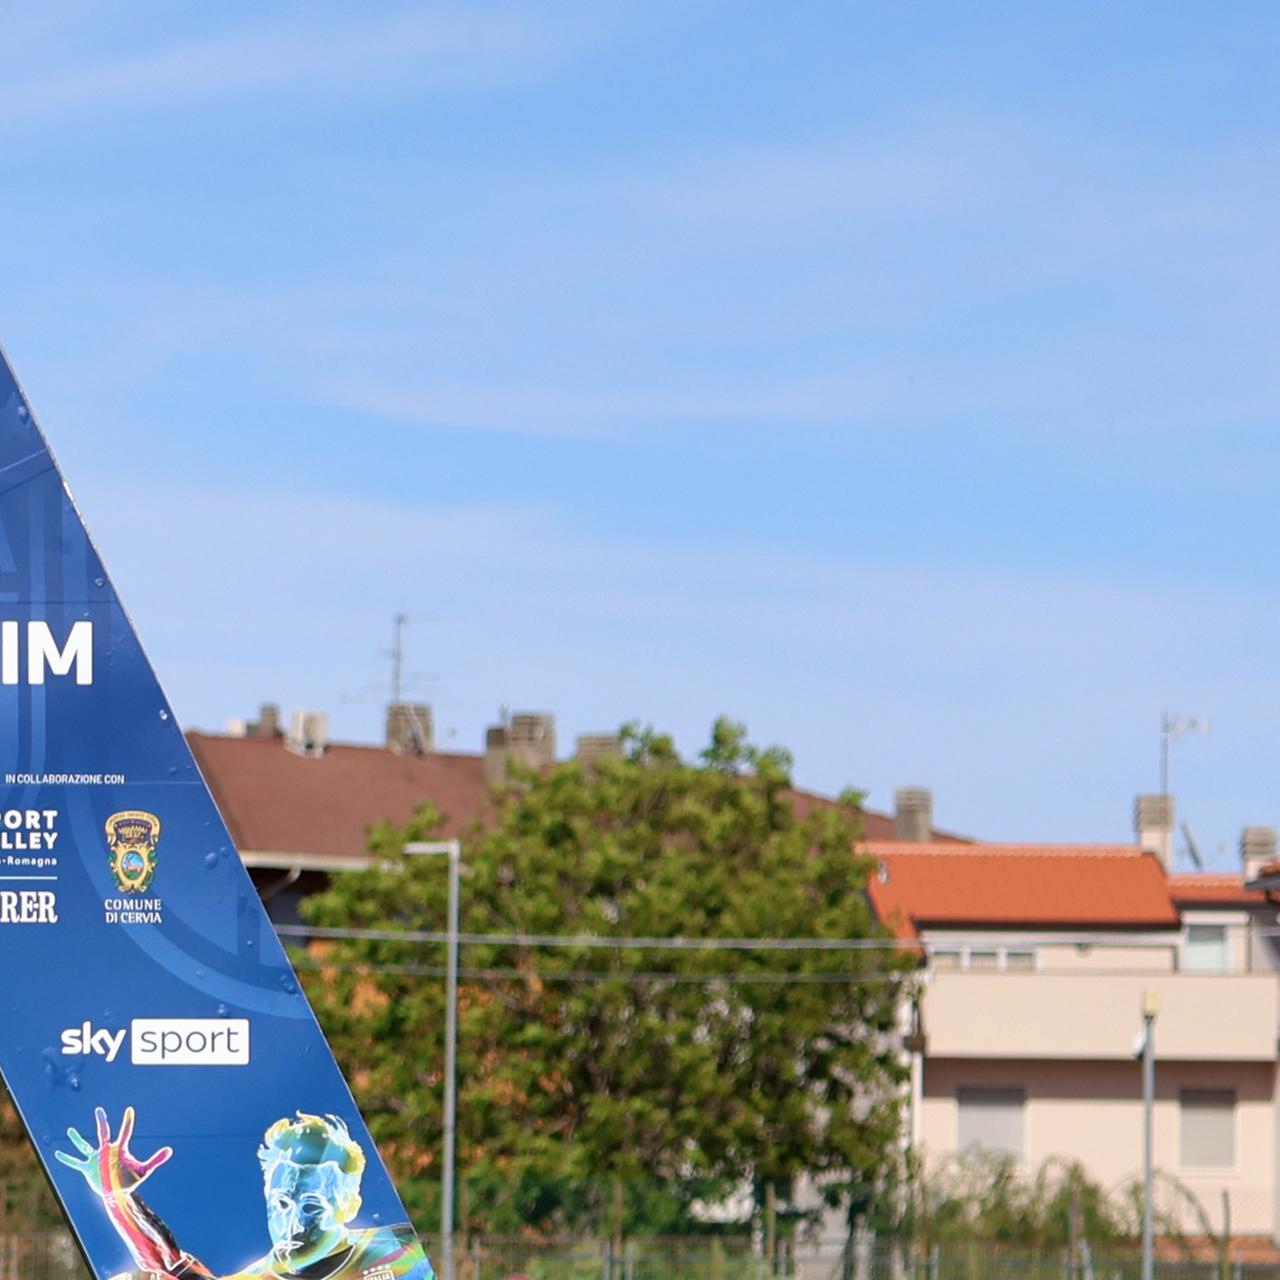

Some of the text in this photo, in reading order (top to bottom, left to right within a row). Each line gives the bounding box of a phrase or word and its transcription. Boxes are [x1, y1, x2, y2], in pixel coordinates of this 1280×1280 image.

[5, 774, 125, 784] IN COLLABORAZIONE CON
[104, 899, 161, 911] COMUNE
[105, 912, 162, 924] DI CERVIA
[60, 1021, 240, 1062] sky sport
